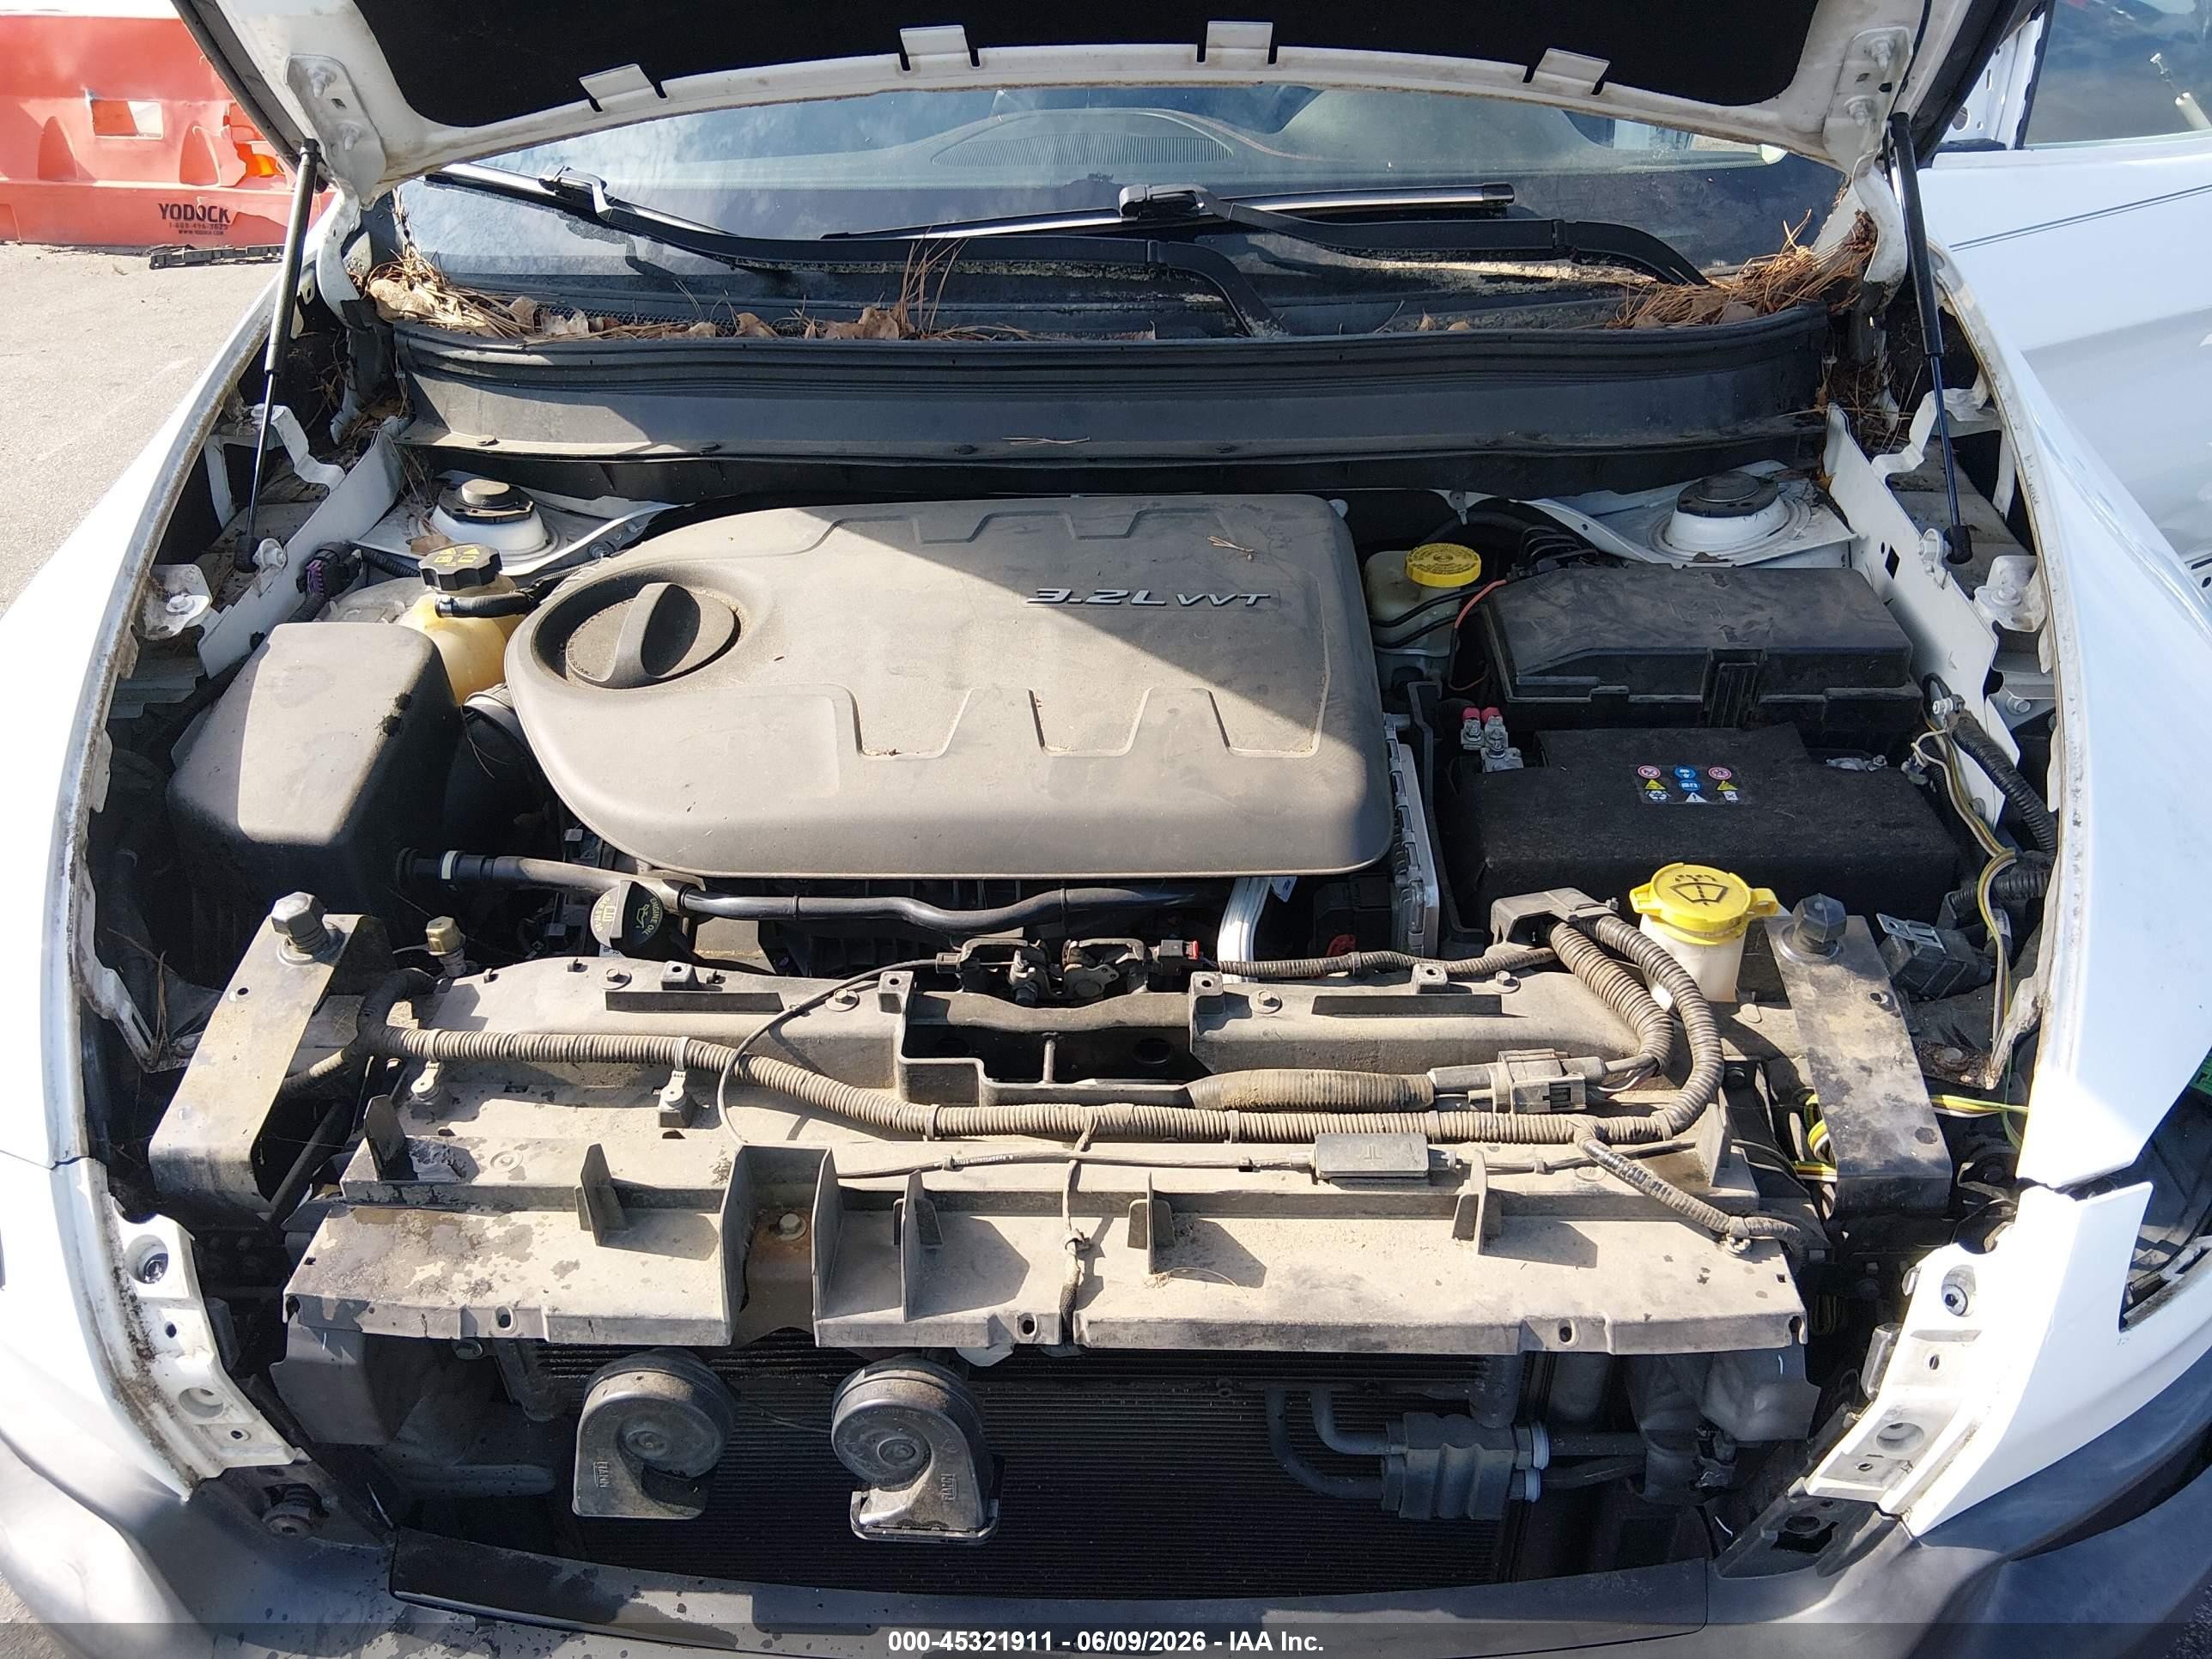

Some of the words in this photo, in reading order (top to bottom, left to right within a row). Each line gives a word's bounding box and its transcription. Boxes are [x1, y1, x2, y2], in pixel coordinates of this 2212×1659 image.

[158, 204, 230, 223] YODOCK
[1026, 587, 1166, 606] 3.2L
[1177, 593, 1270, 606] VVT
[650, 897, 660, 924] ENGINE
[641, 924, 654, 935] OIL
